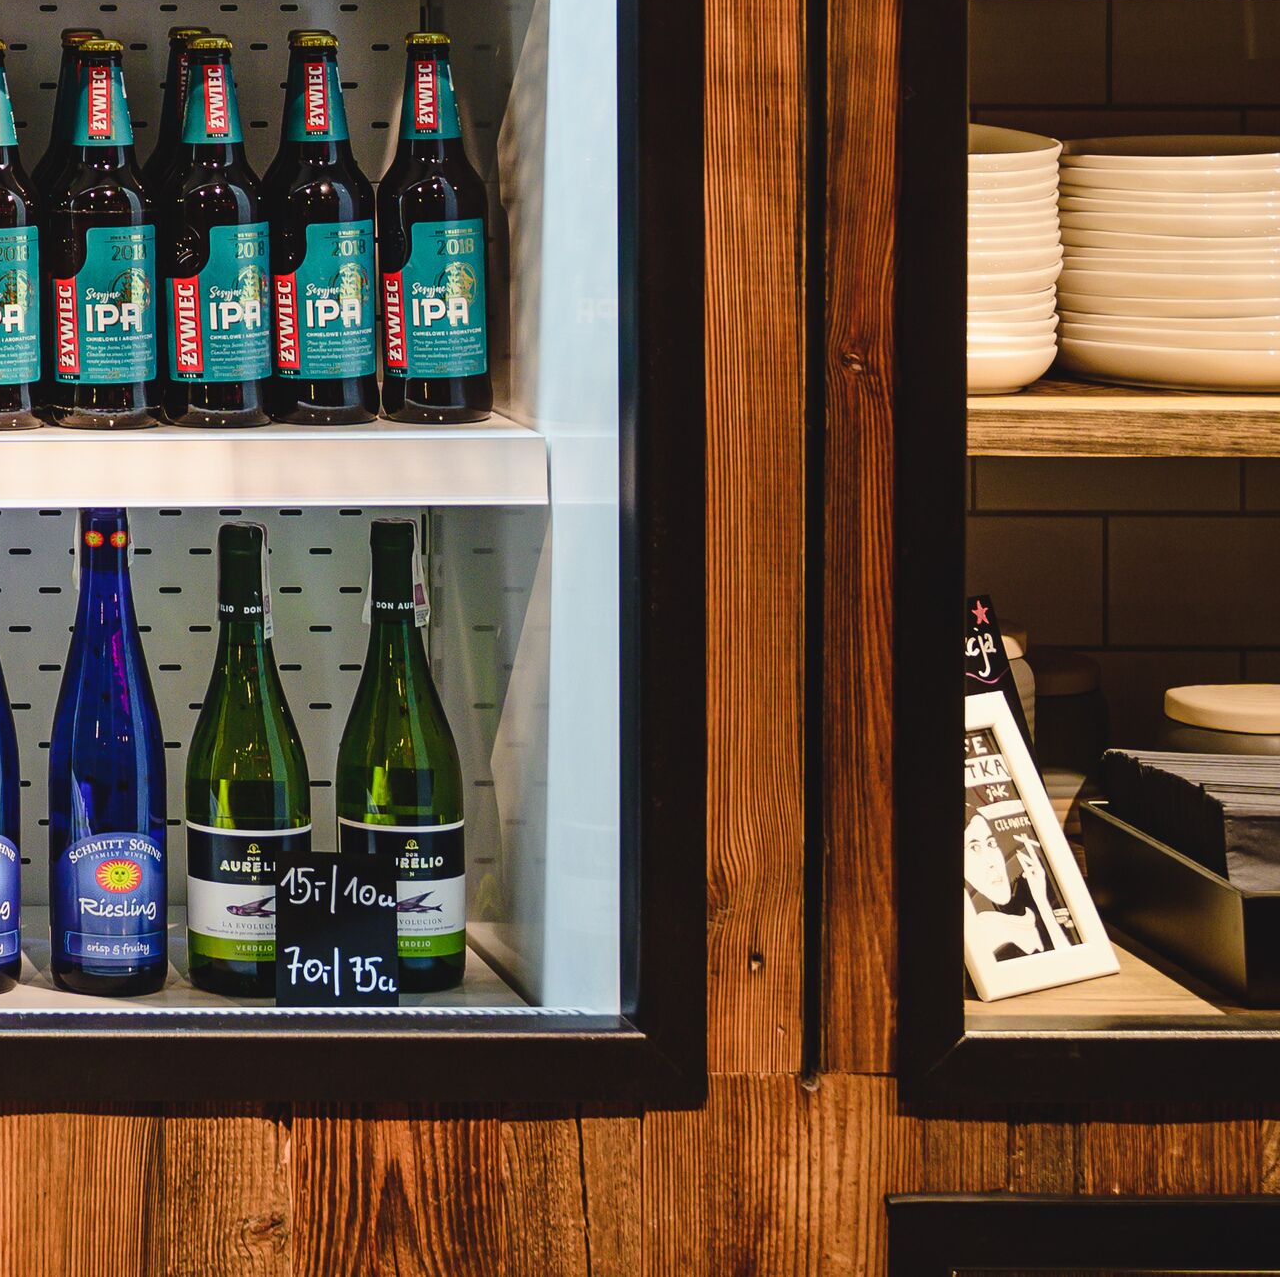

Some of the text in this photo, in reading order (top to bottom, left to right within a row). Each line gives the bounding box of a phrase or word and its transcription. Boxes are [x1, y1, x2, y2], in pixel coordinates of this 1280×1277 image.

[418, 62, 434, 125] ŻYWIEC
[437, 238, 474, 256] 2018
[411, 298, 469, 327] IPA
[178, 285, 196, 367] ŻYWIEC
[68, 838, 162, 864] SCHMITT SÖHNE
[219, 859, 276, 873] AURELI
[78, 897, 157, 920] Riesling
[87, 941, 111, 955] crisp
[121, 941, 149, 954] fruity
[236, 944, 273, 952] VERDEJO
